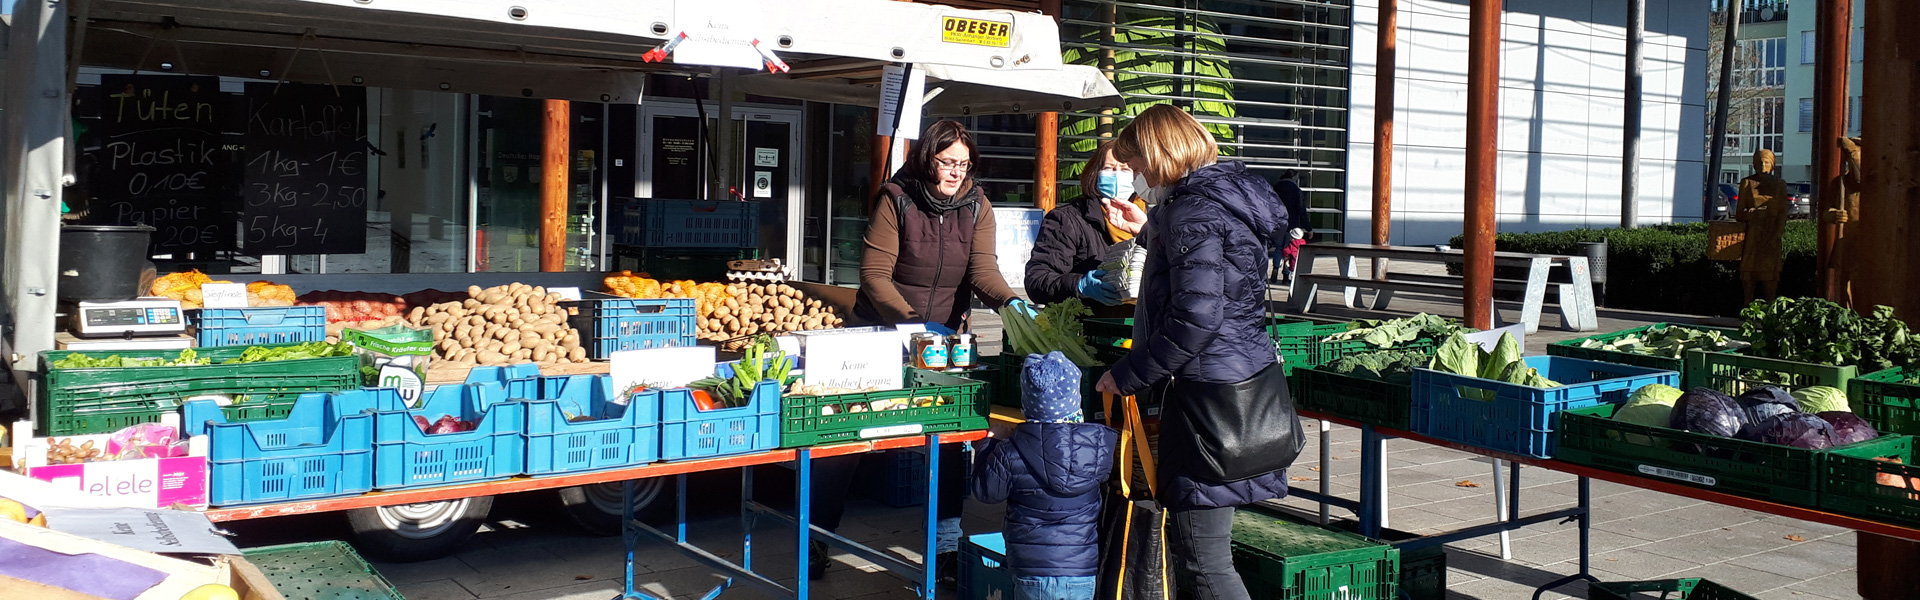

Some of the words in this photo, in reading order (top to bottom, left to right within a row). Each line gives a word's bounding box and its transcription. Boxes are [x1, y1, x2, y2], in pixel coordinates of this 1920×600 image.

[944, 18, 1009, 37] OBESER
[109, 88, 213, 124] Tüten
[247, 97, 367, 142] Kartoffel
[106, 138, 216, 171] Plastik
[128, 171, 207, 196] 0,10€
[110, 198, 208, 225] Papier
[369, 340, 391, 352] Frische
[391, 345, 417, 353] Kräuter
[841, 360, 869, 371] Keine
